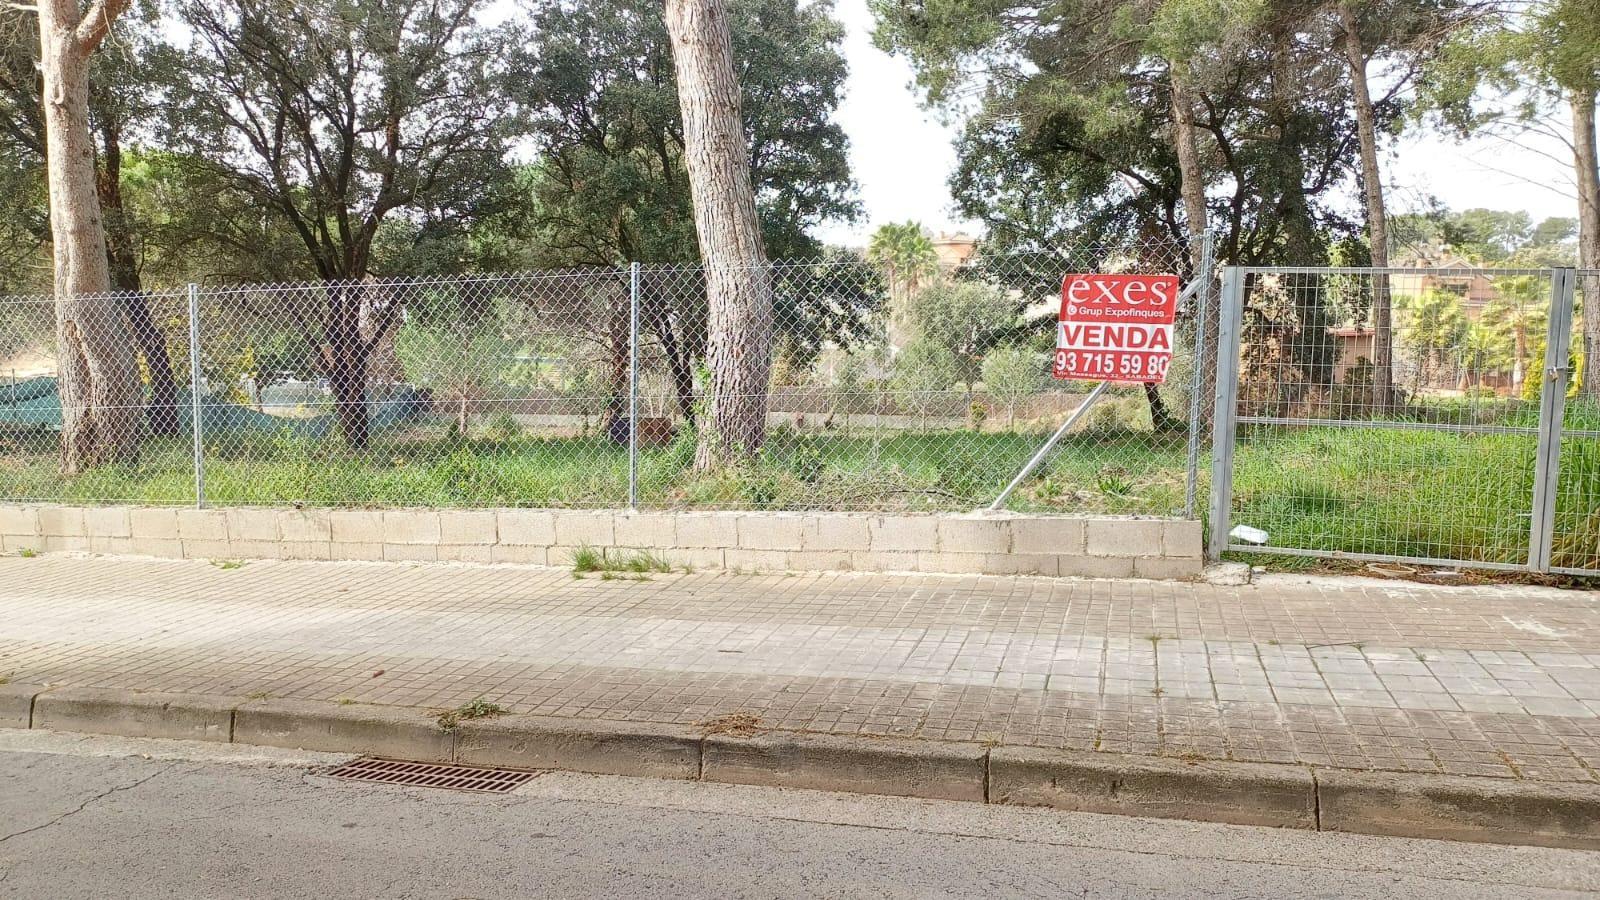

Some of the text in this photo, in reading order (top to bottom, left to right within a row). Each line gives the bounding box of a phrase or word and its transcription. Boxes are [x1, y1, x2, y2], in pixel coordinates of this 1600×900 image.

[1079, 306, 1164, 318] Grup Expofinques
[1063, 325, 1170, 349] VENDA
[1056, 352, 1168, 375] 93 715 59 80
